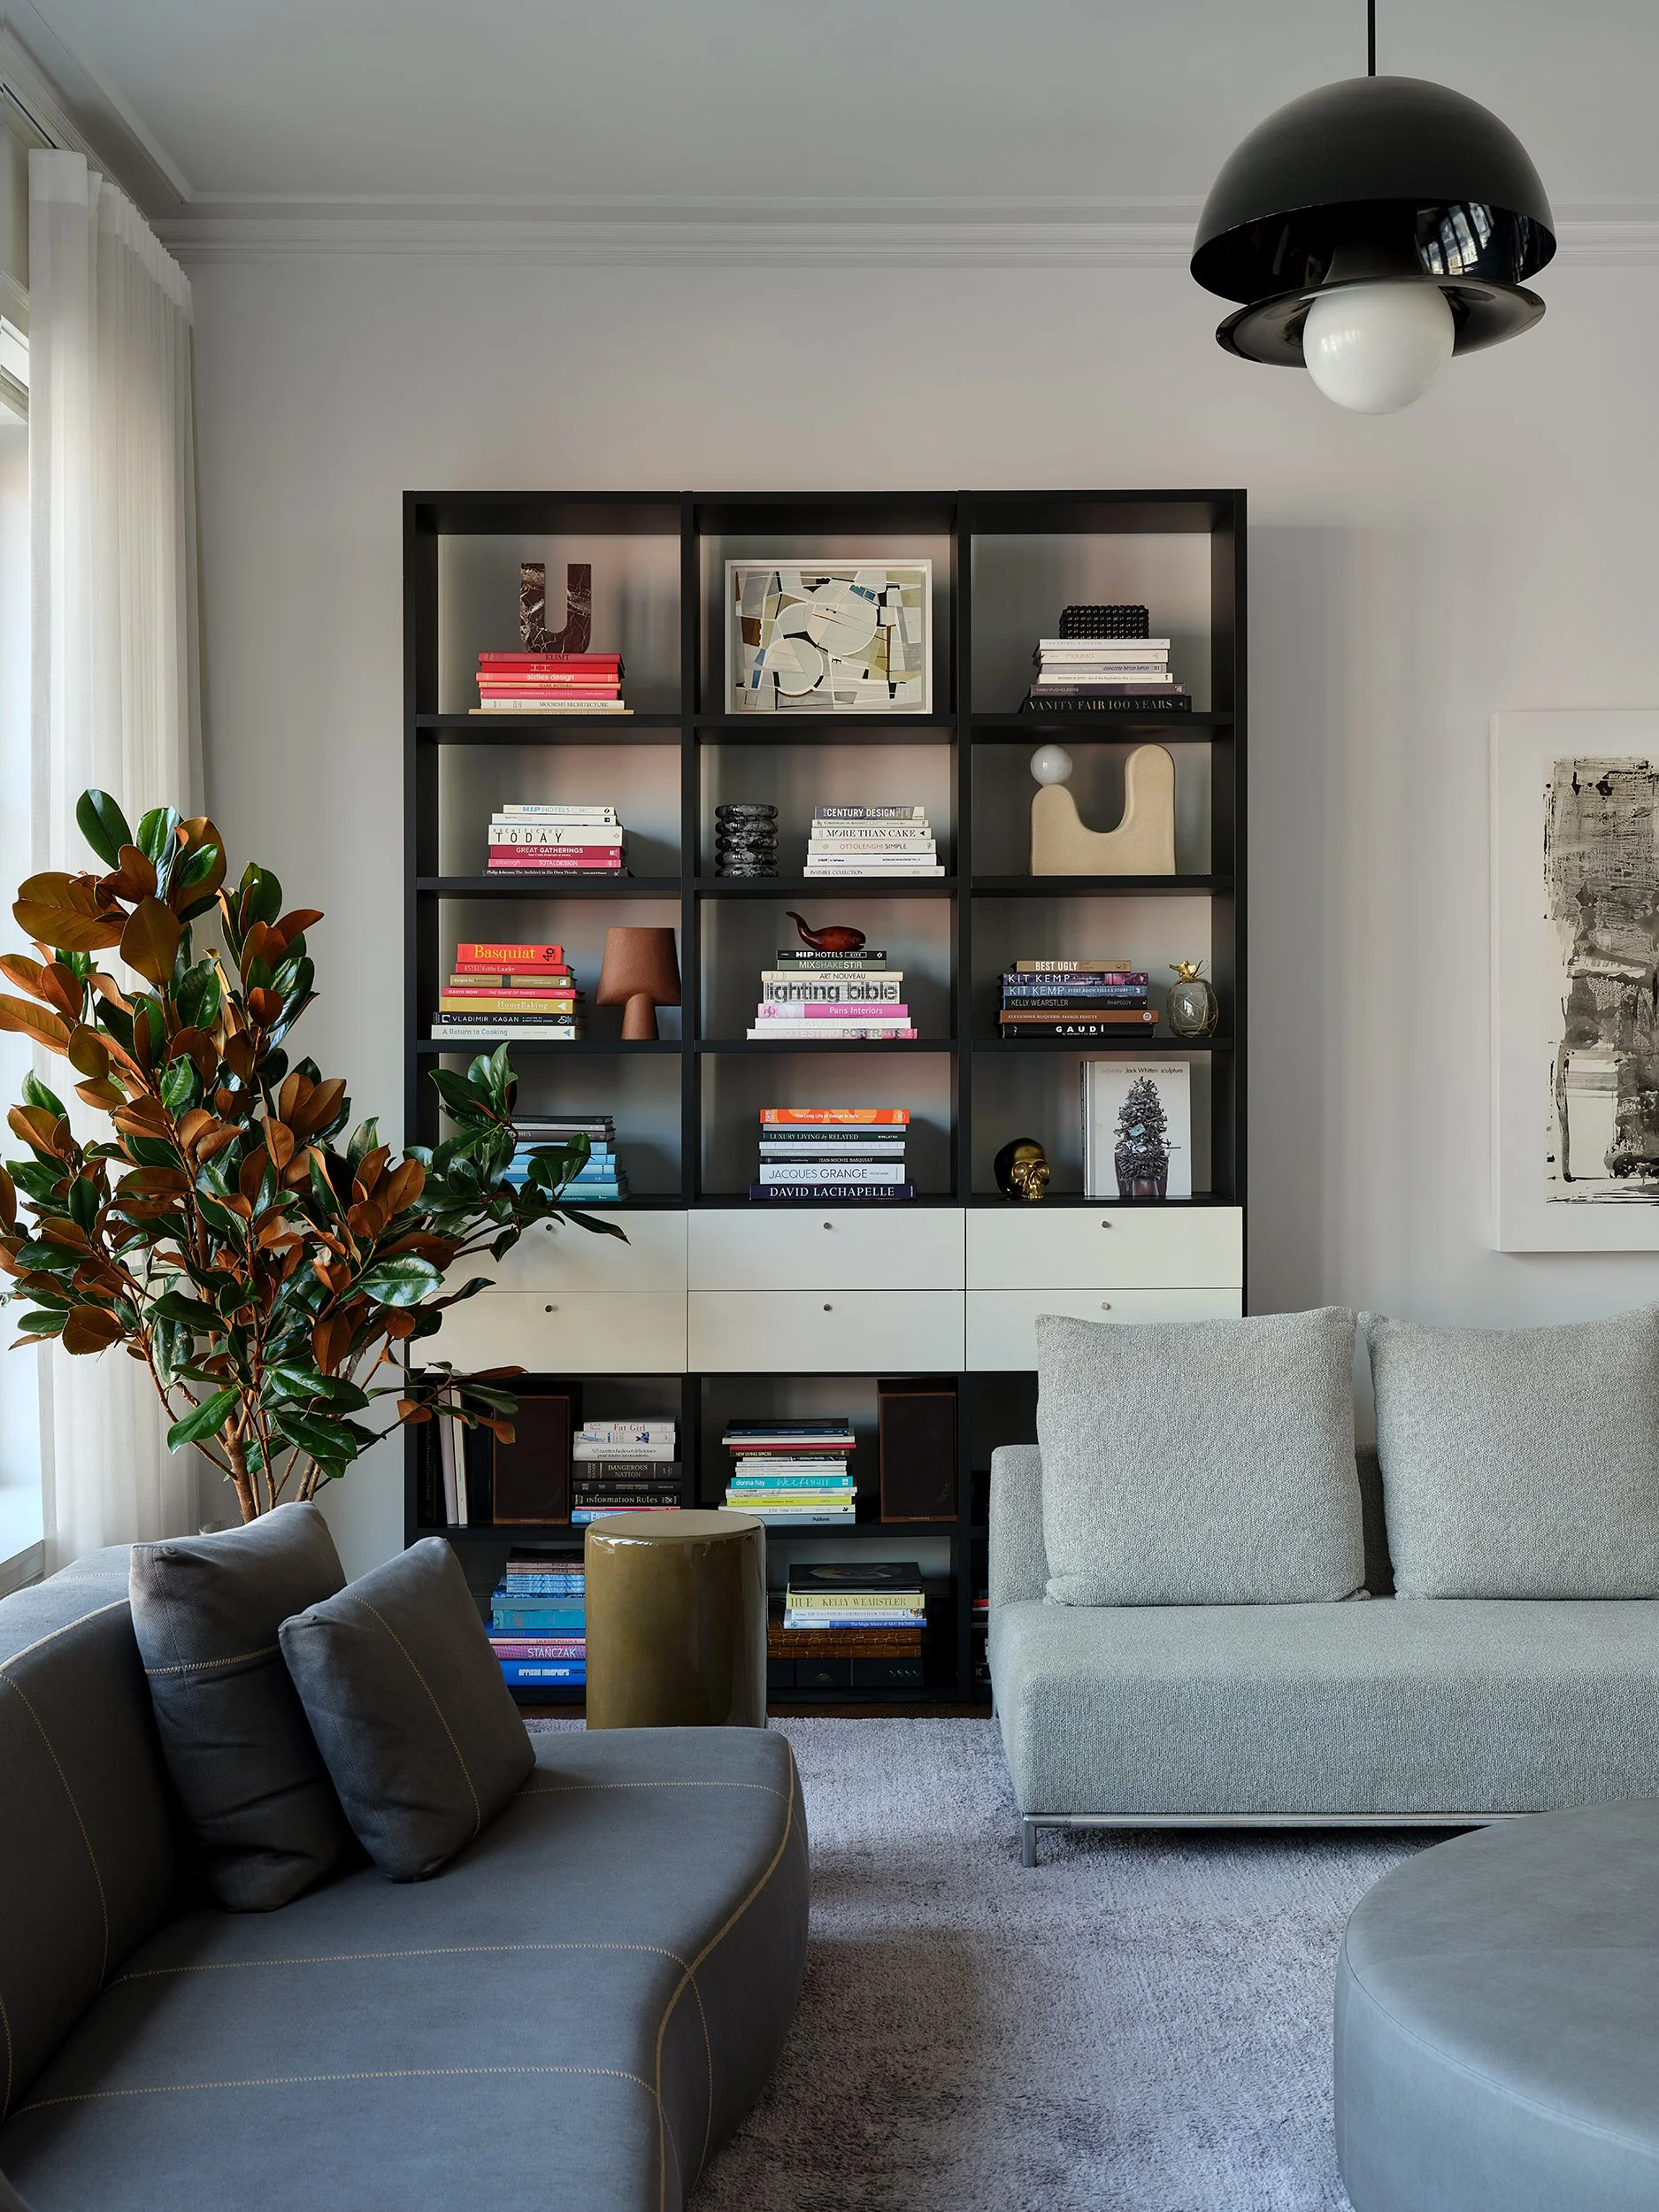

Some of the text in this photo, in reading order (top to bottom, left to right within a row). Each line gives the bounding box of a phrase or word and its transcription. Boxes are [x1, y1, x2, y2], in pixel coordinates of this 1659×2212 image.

[1029, 700, 1172, 710] VANITY FAIR 100 YEARS
[826, 808, 895, 817] CENTURY DESIGN
[495, 833, 563, 843] TODAY
[474, 944, 536, 963] Basquiat
[1035, 962, 1078, 971] BEST UGLY
[764, 982, 897, 1003] lighting bible
[1009, 986, 1064, 995] KIT KEMP
[497, 1001, 548, 1010] HomeBaking
[842, 1029, 905, 1038] PORTRAITS
[769, 1169, 868, 1179] JACQUES GRANGE
[770, 1187, 895, 1197] DAVID LACHAPELLE
[790, 1597, 906, 1607] HUE KELLY WEARSTLER
[527, 1646, 576, 1657] STAŃCZAK
